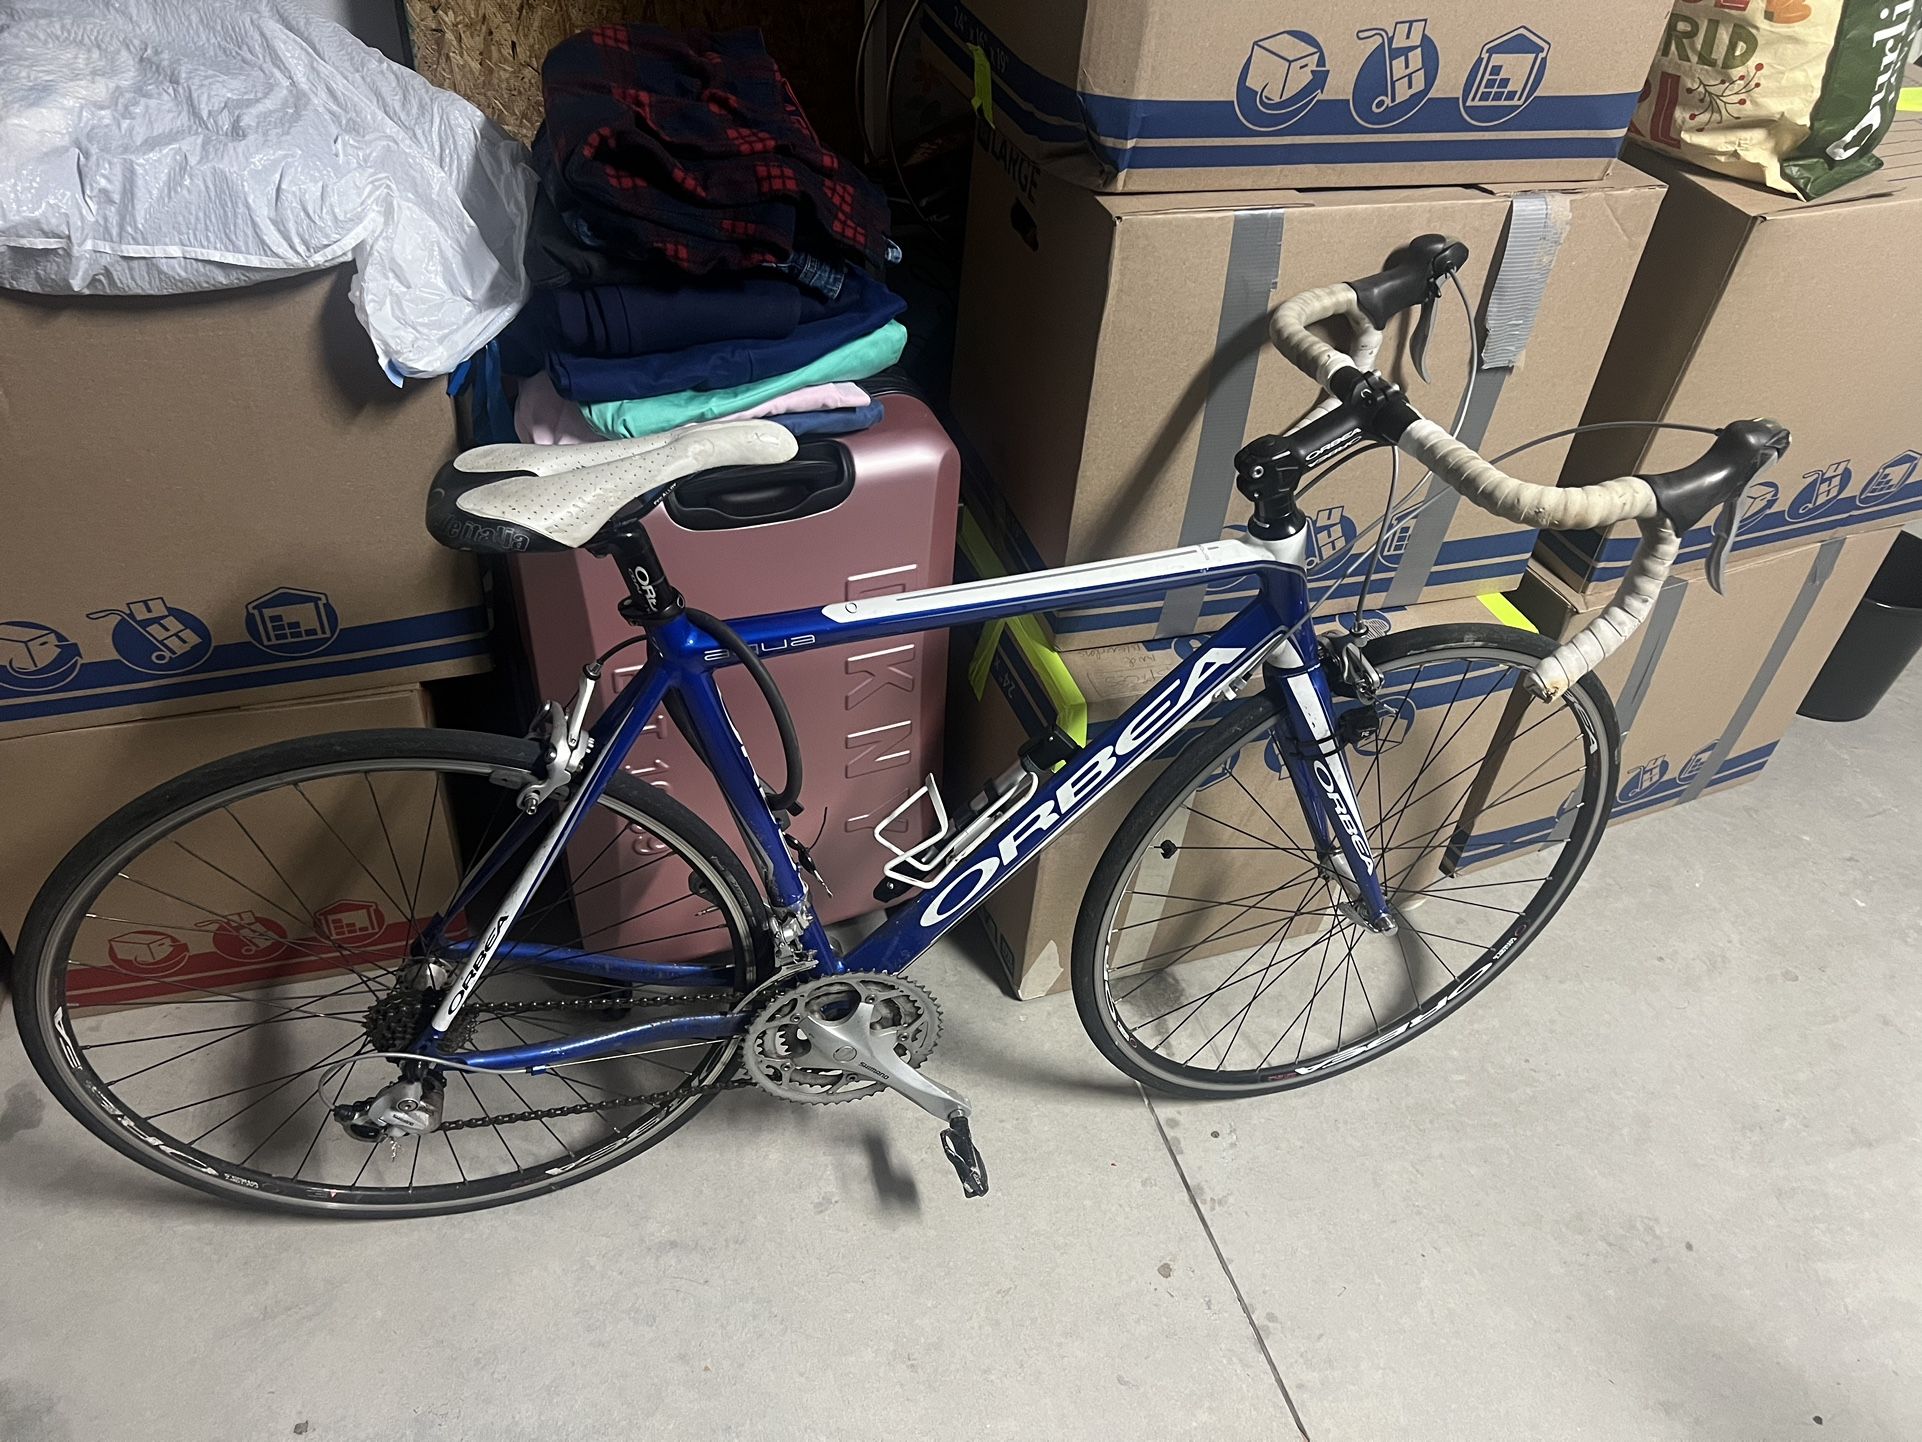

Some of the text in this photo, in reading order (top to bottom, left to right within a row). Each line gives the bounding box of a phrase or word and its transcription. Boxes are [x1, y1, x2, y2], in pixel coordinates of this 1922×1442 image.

[704, 634, 816, 661] aua
[920, 648, 1246, 927] ORBEA
[1314, 760, 1374, 876] ORBEA
[448, 915, 509, 1015] ORBEA
